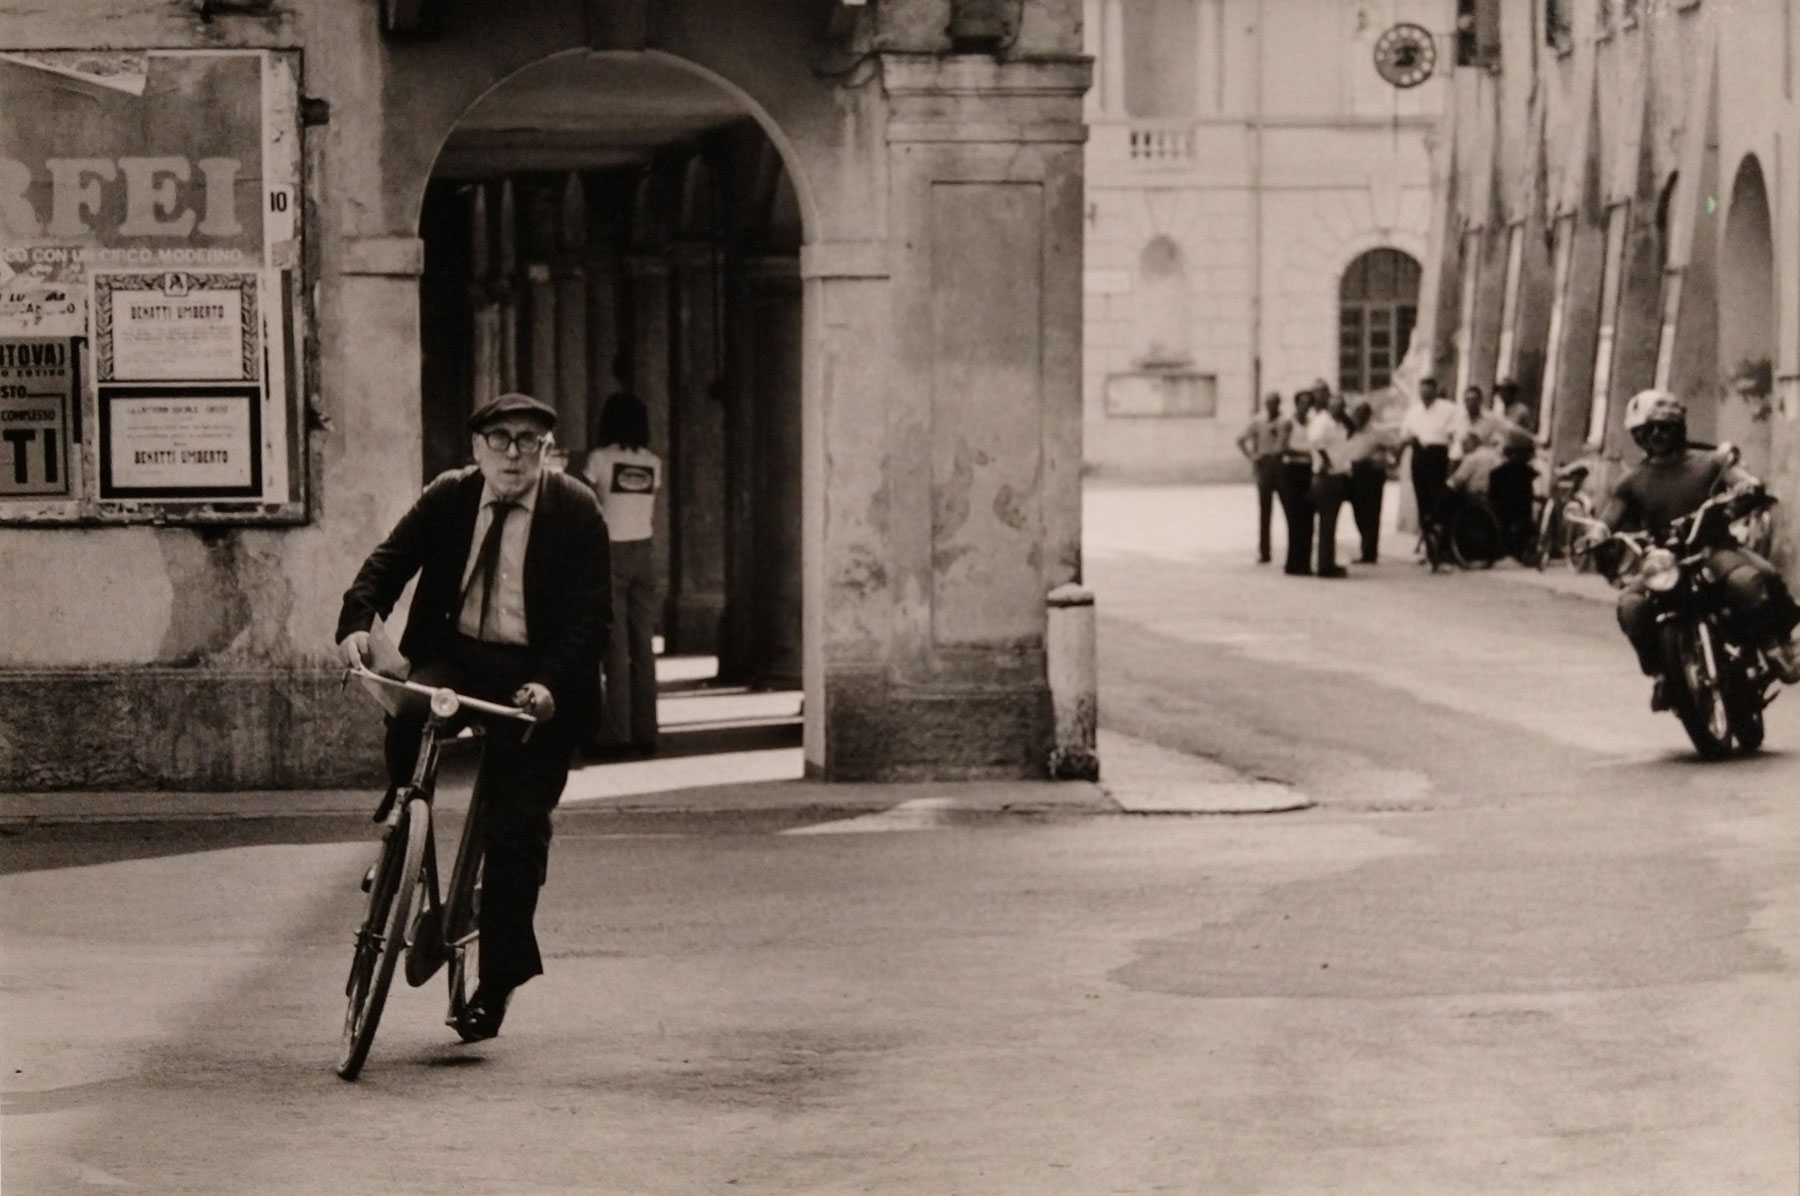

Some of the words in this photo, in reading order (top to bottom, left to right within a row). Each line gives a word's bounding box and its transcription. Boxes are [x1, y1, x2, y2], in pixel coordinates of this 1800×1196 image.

[270, 191, 287, 212] 10
[32, 249, 67, 263] CON
[158, 248, 244, 262] MODERNO
[177, 305, 224, 319] UMBERTO
[181, 450, 229, 464] UMBERTO
